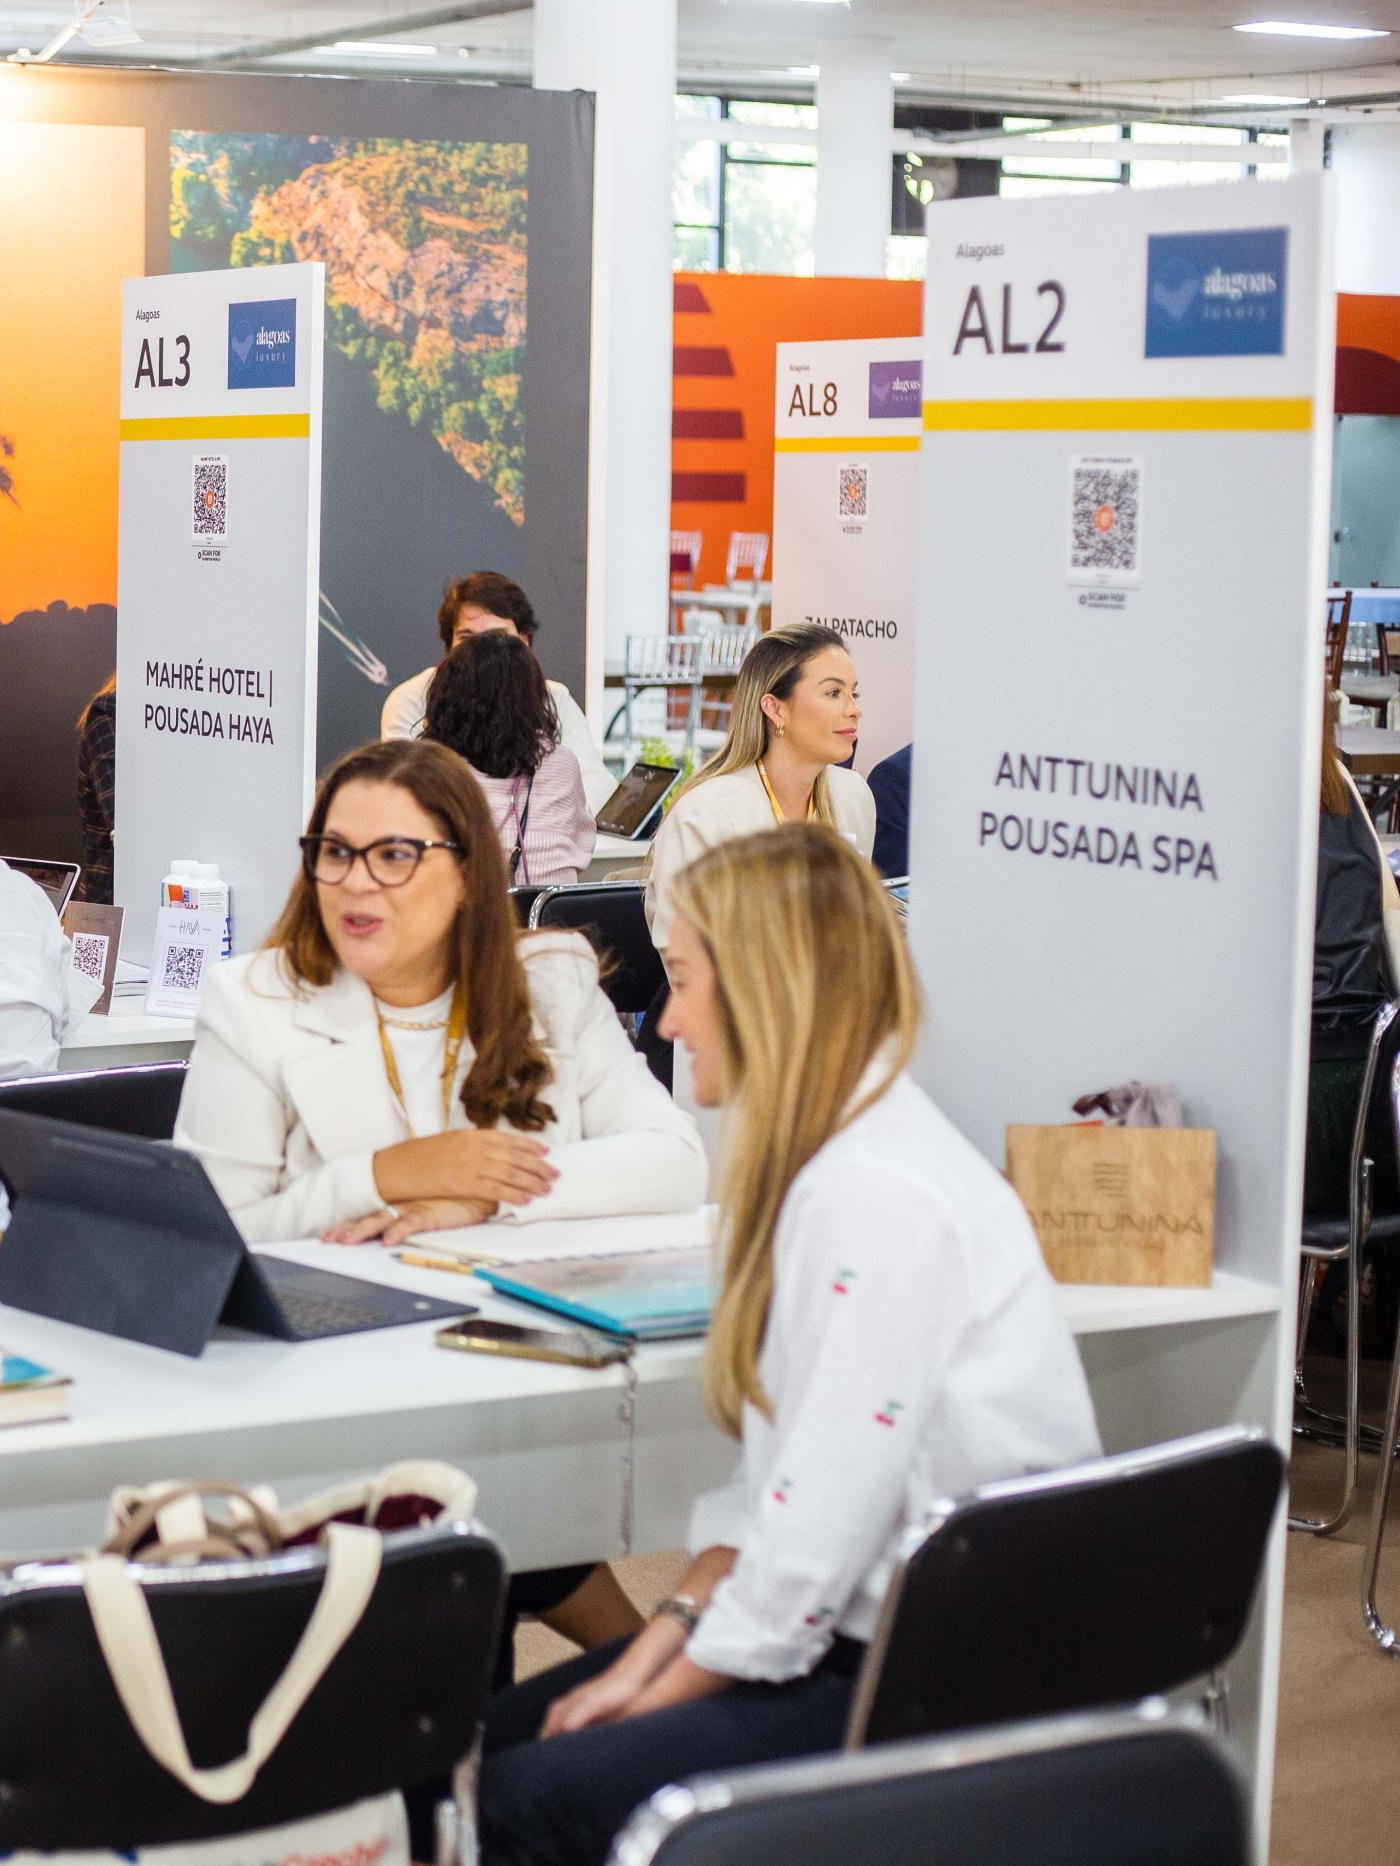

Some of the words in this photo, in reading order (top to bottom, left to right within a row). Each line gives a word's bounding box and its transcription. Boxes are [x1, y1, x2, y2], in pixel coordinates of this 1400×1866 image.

[955, 244, 1006, 262] Alagoas
[1204, 266, 1278, 300] alagoas
[135, 309, 161, 323] Alagoas
[952, 279, 1066, 356] AL2
[256, 326, 291, 350] alagoas
[134, 334, 191, 389] AL3
[256, 351, 287, 364] luxury
[788, 382, 838, 417] AL8
[145, 657, 204, 692] MAHRÉ
[208, 666, 266, 699] HOTEL
[144, 703, 225, 739] POUSADA
[228, 713, 274, 745] HAYA
[994, 751, 1205, 813] ANTTUNINA
[979, 810, 1143, 871] POUSADA
[1151, 833, 1219, 881] SPA
